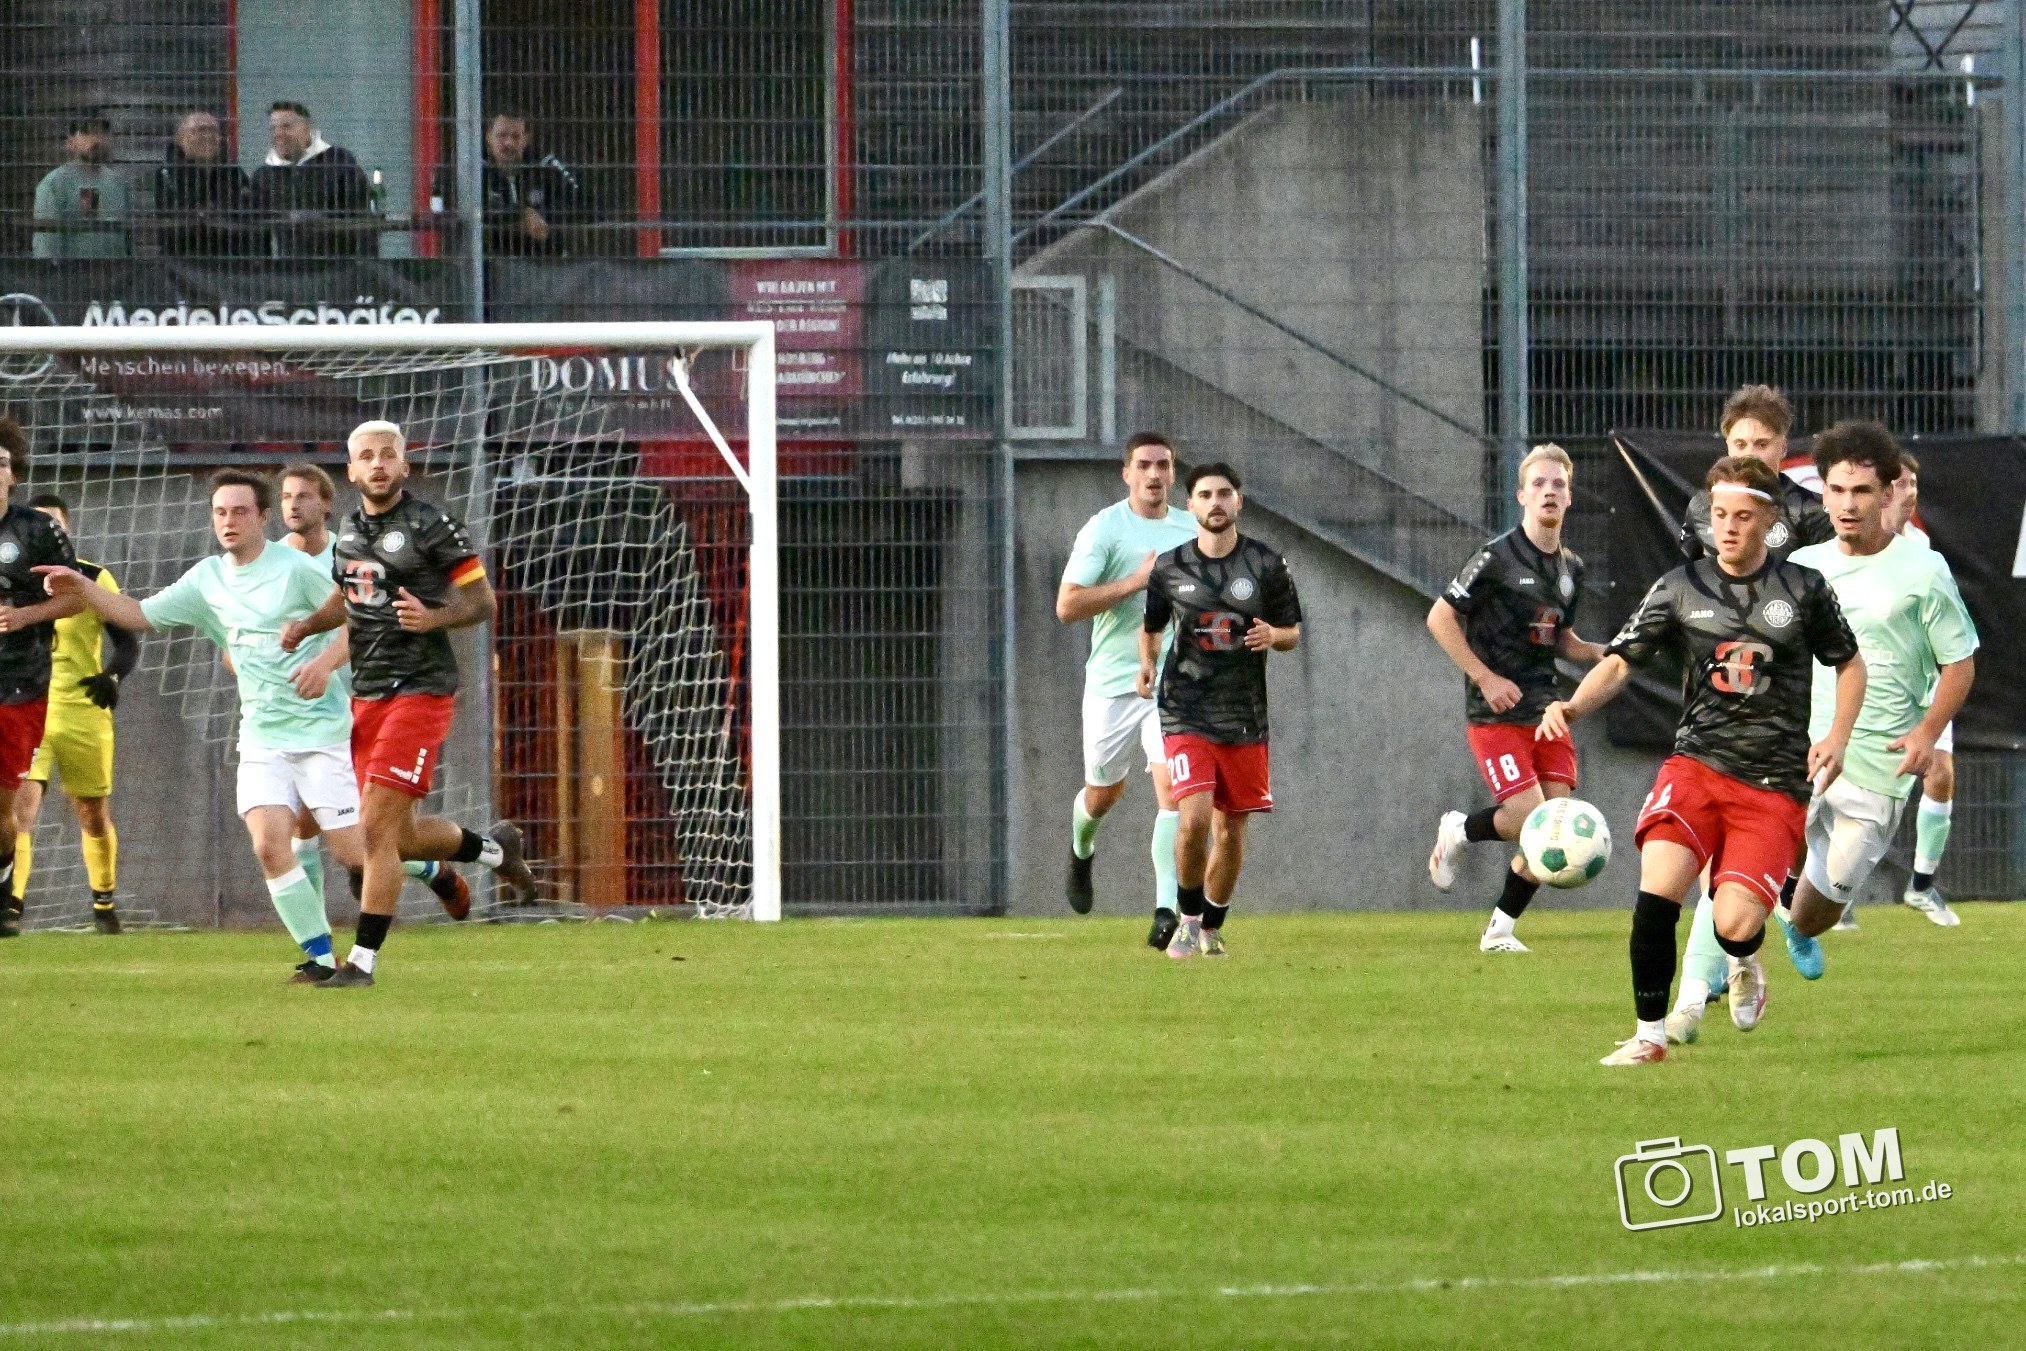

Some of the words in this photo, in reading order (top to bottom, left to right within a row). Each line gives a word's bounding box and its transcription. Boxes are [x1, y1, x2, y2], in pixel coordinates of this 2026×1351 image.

[1690, 610, 1714, 619] JAKO
[1167, 753, 1190, 787] 20
[1499, 753, 1520, 782] 8
